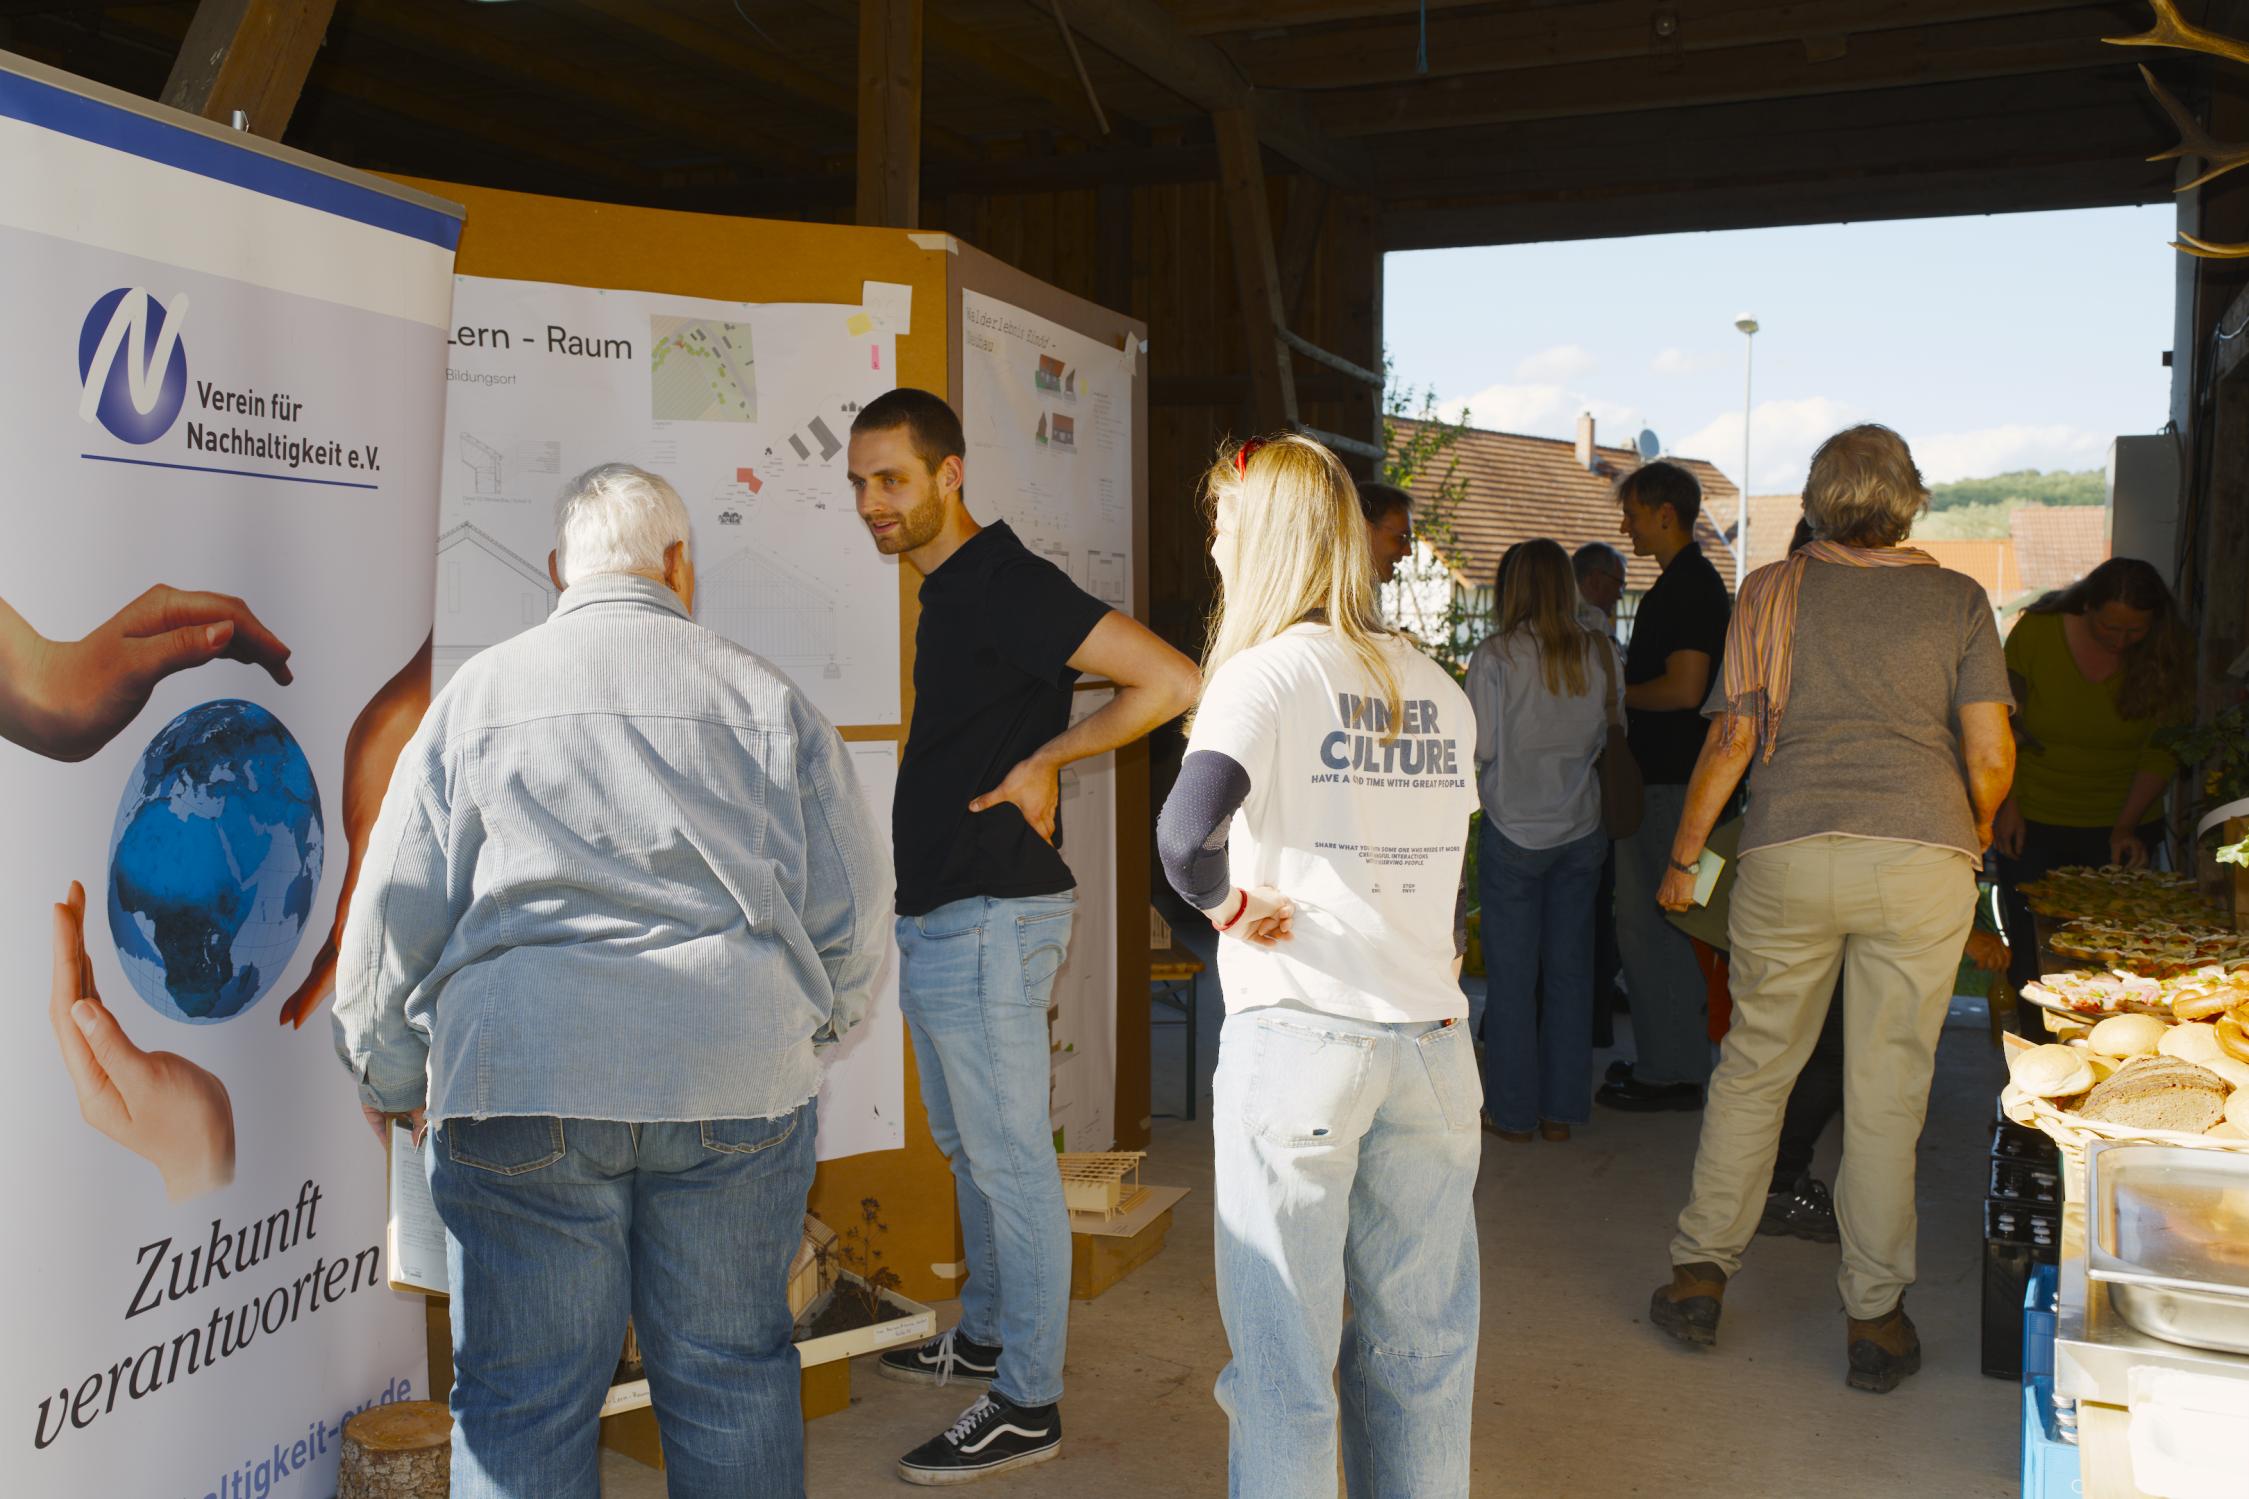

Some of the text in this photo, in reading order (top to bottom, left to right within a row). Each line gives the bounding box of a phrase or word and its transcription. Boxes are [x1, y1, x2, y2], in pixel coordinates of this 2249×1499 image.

[446, 325, 511, 350] ern
[546, 324, 633, 360] Raum
[445, 367, 517, 387] Bildungsort
[196, 380, 304, 423] Verein für
[187, 421, 381, 472] Nachhaltigkeit e.V.
[1338, 693, 1441, 734] INNER
[1320, 730, 1458, 775] CULTURE
[1311, 773, 1339, 784] HAVE
[1342, 774, 1350, 783] A
[1366, 778, 1385, 788] TIME
[1387, 778, 1410, 788] WITH
[1412, 779, 1437, 789] GREAT
[1437, 779, 1465, 789] PEOPLE
[1314, 841, 1337, 849] SHARE
[1338, 843, 1359, 851] WHAT
[124, 1179, 324, 1320] Zukunft
[34, 1245, 380, 1450] verantworten
